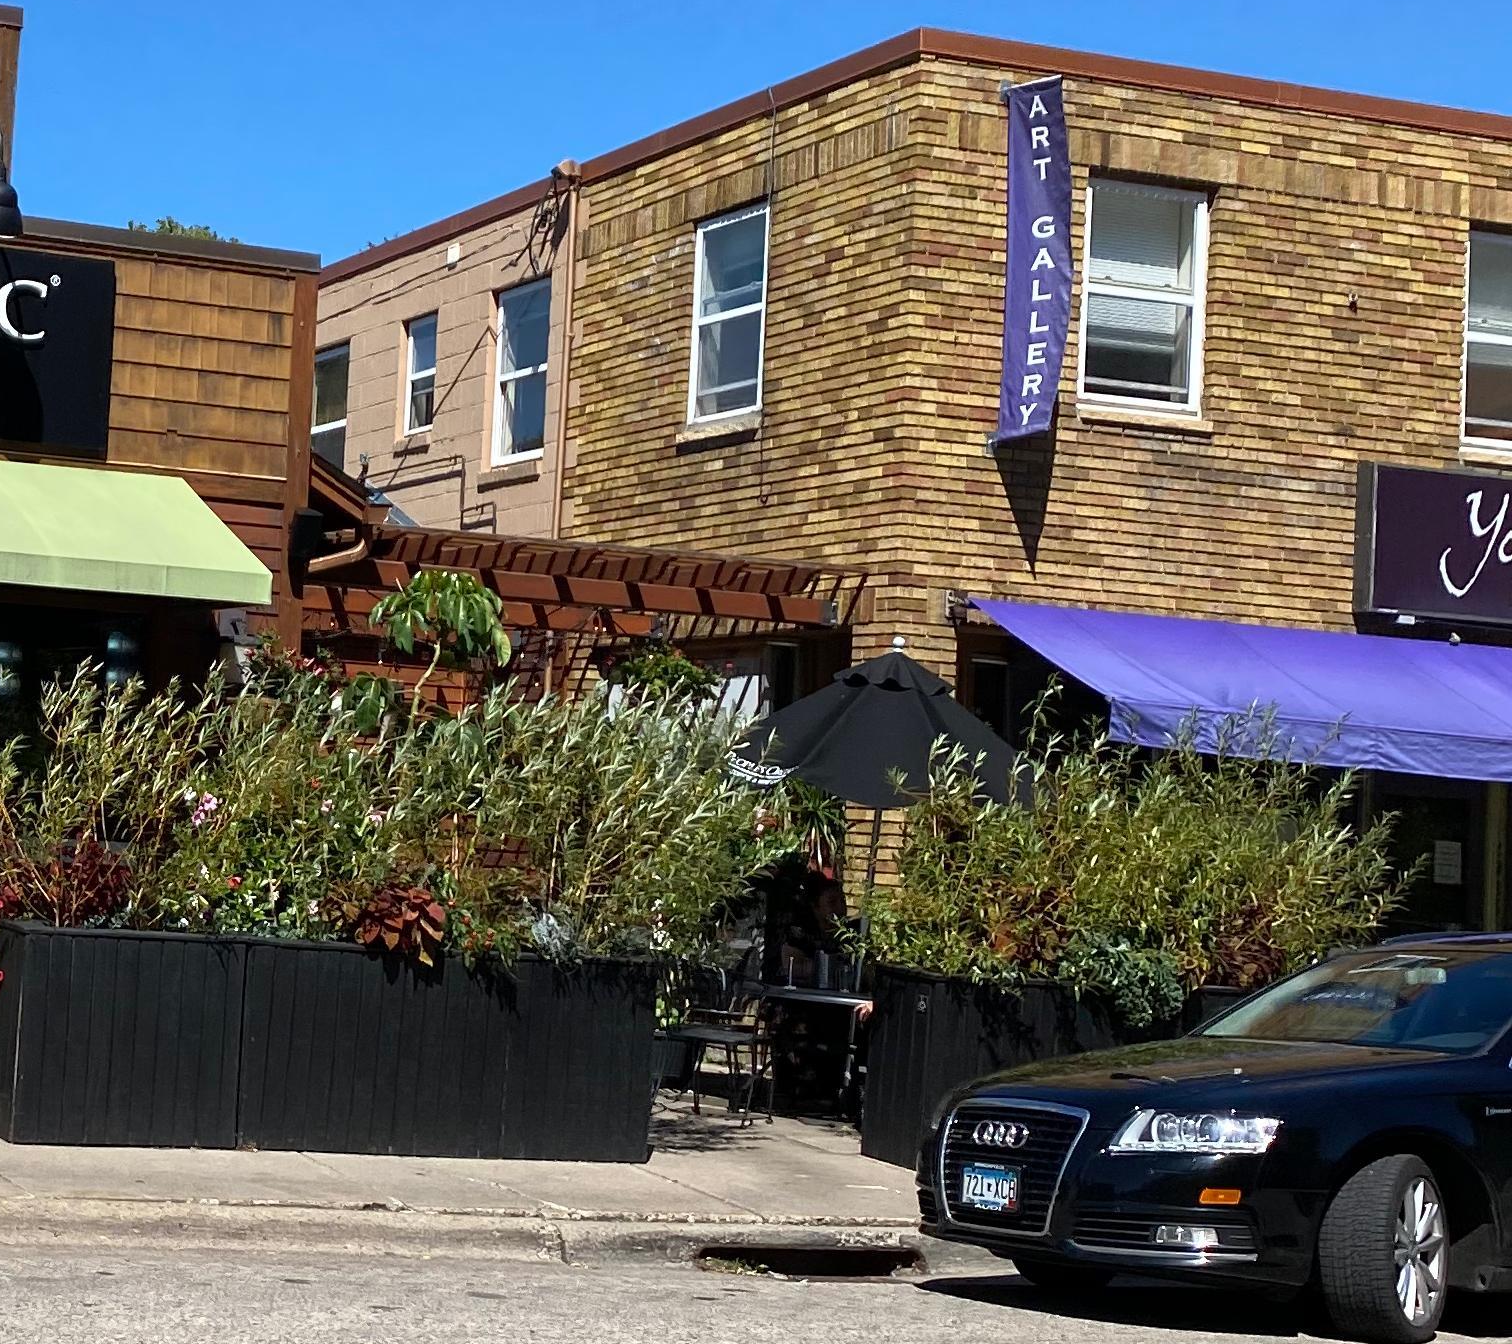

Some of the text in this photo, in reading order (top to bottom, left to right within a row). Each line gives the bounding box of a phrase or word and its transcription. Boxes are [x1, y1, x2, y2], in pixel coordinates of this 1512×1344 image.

[1019, 95, 1056, 426] ART GALLERY
[965, 1174, 985, 1197] 721
